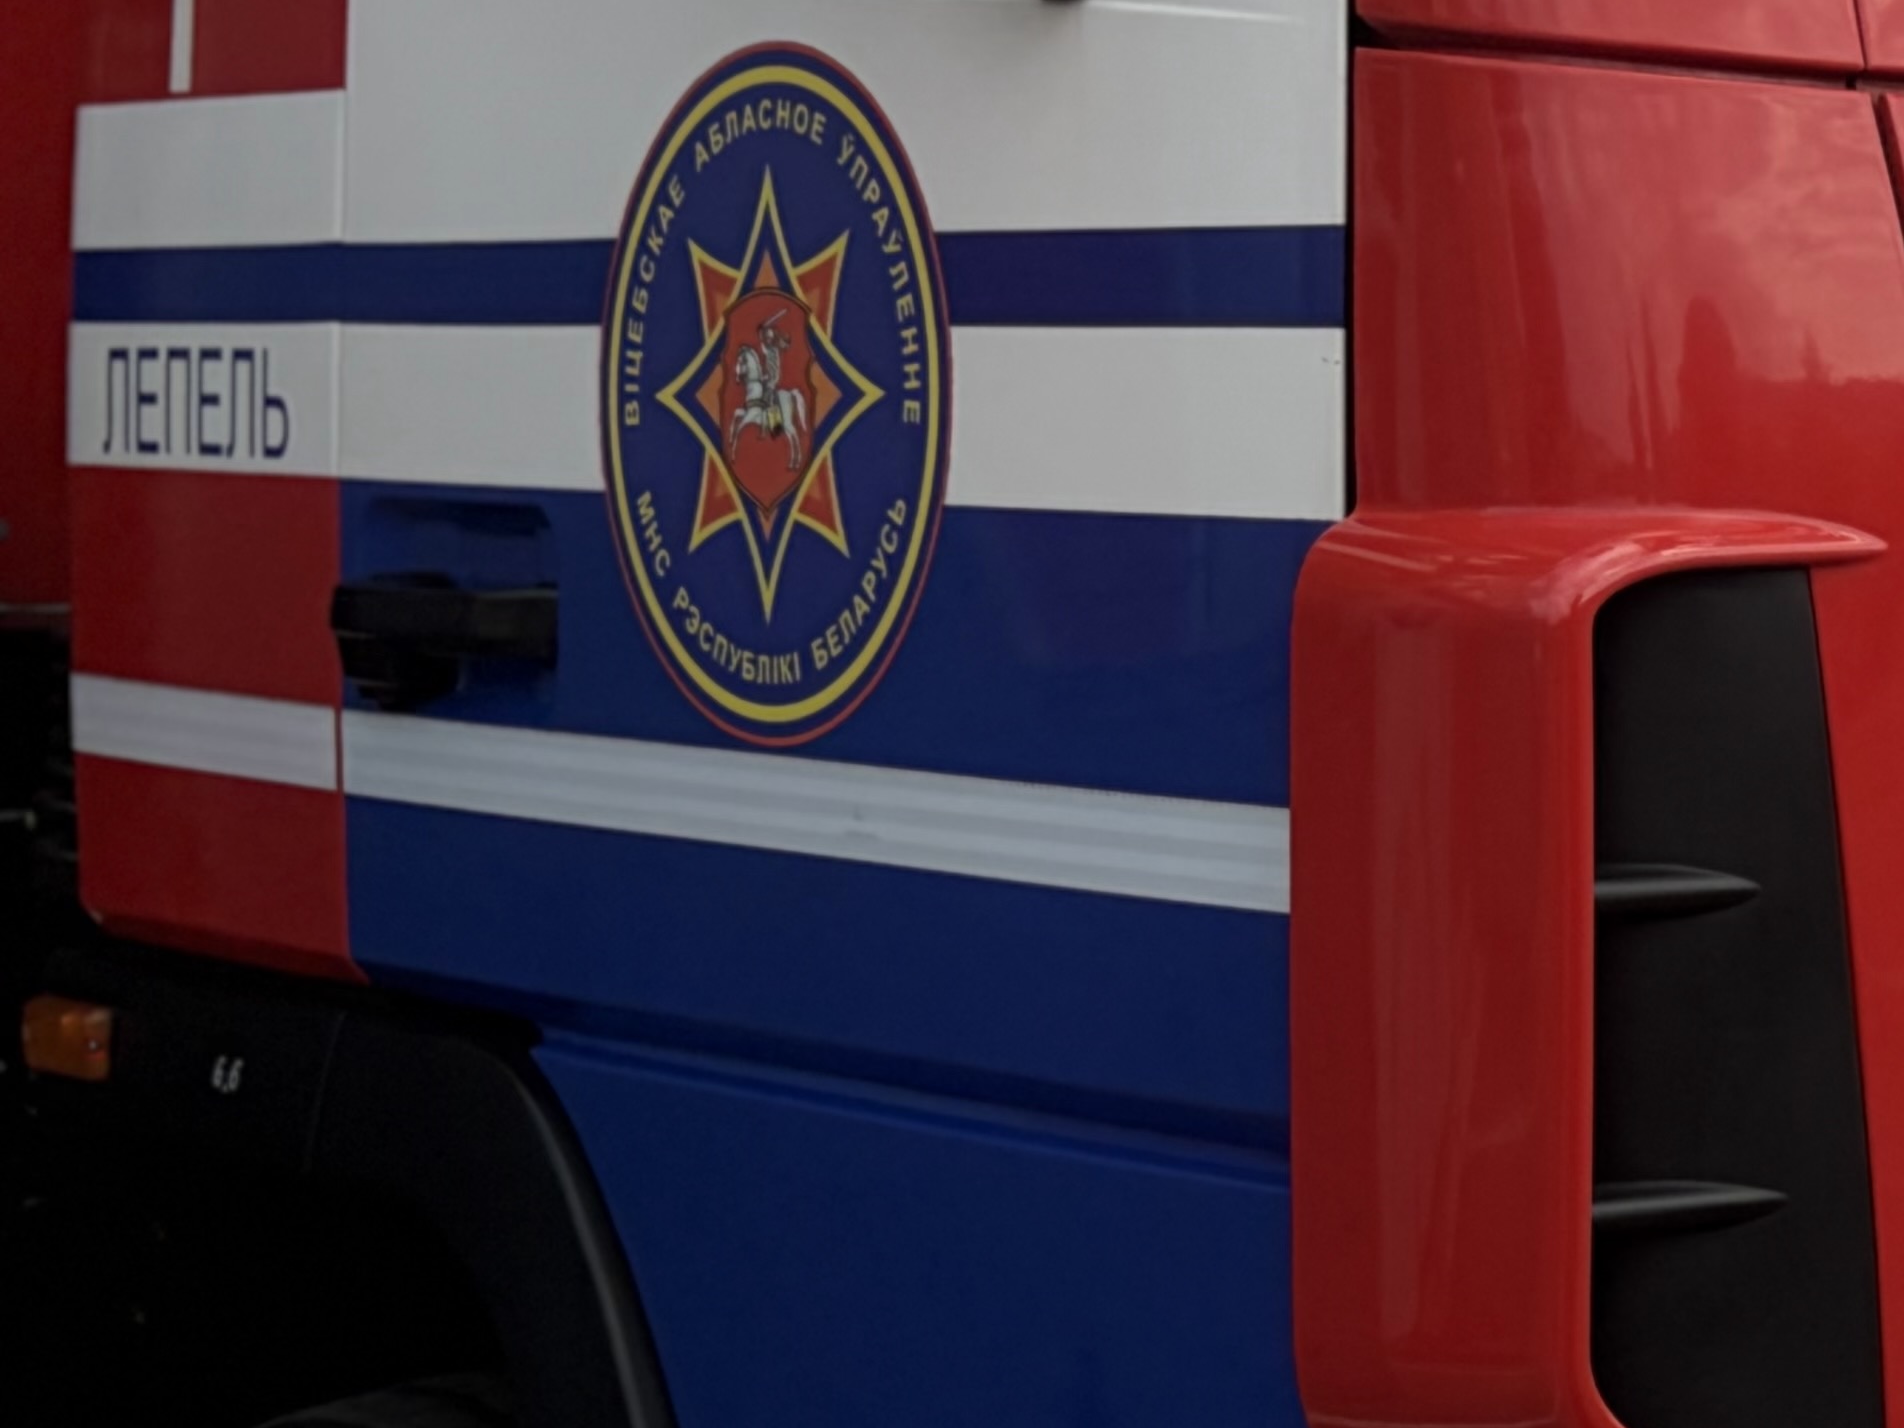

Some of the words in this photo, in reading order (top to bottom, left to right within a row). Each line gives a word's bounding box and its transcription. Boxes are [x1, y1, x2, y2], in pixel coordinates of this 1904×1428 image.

[624, 175, 685, 426] ВІЦЕБСКАЕ
[693, 98, 827, 172] АБЛАСНОЕ
[836, 133, 921, 424] ЎПРАЎЛЕННЕ
[103, 347, 290, 458] ЛЕПЕЛЬ
[636, 491, 671, 576] МНС
[673, 586, 800, 684] РЭСПУБЛІКІ
[810, 498, 907, 670] БЕЛАРУСЬ
